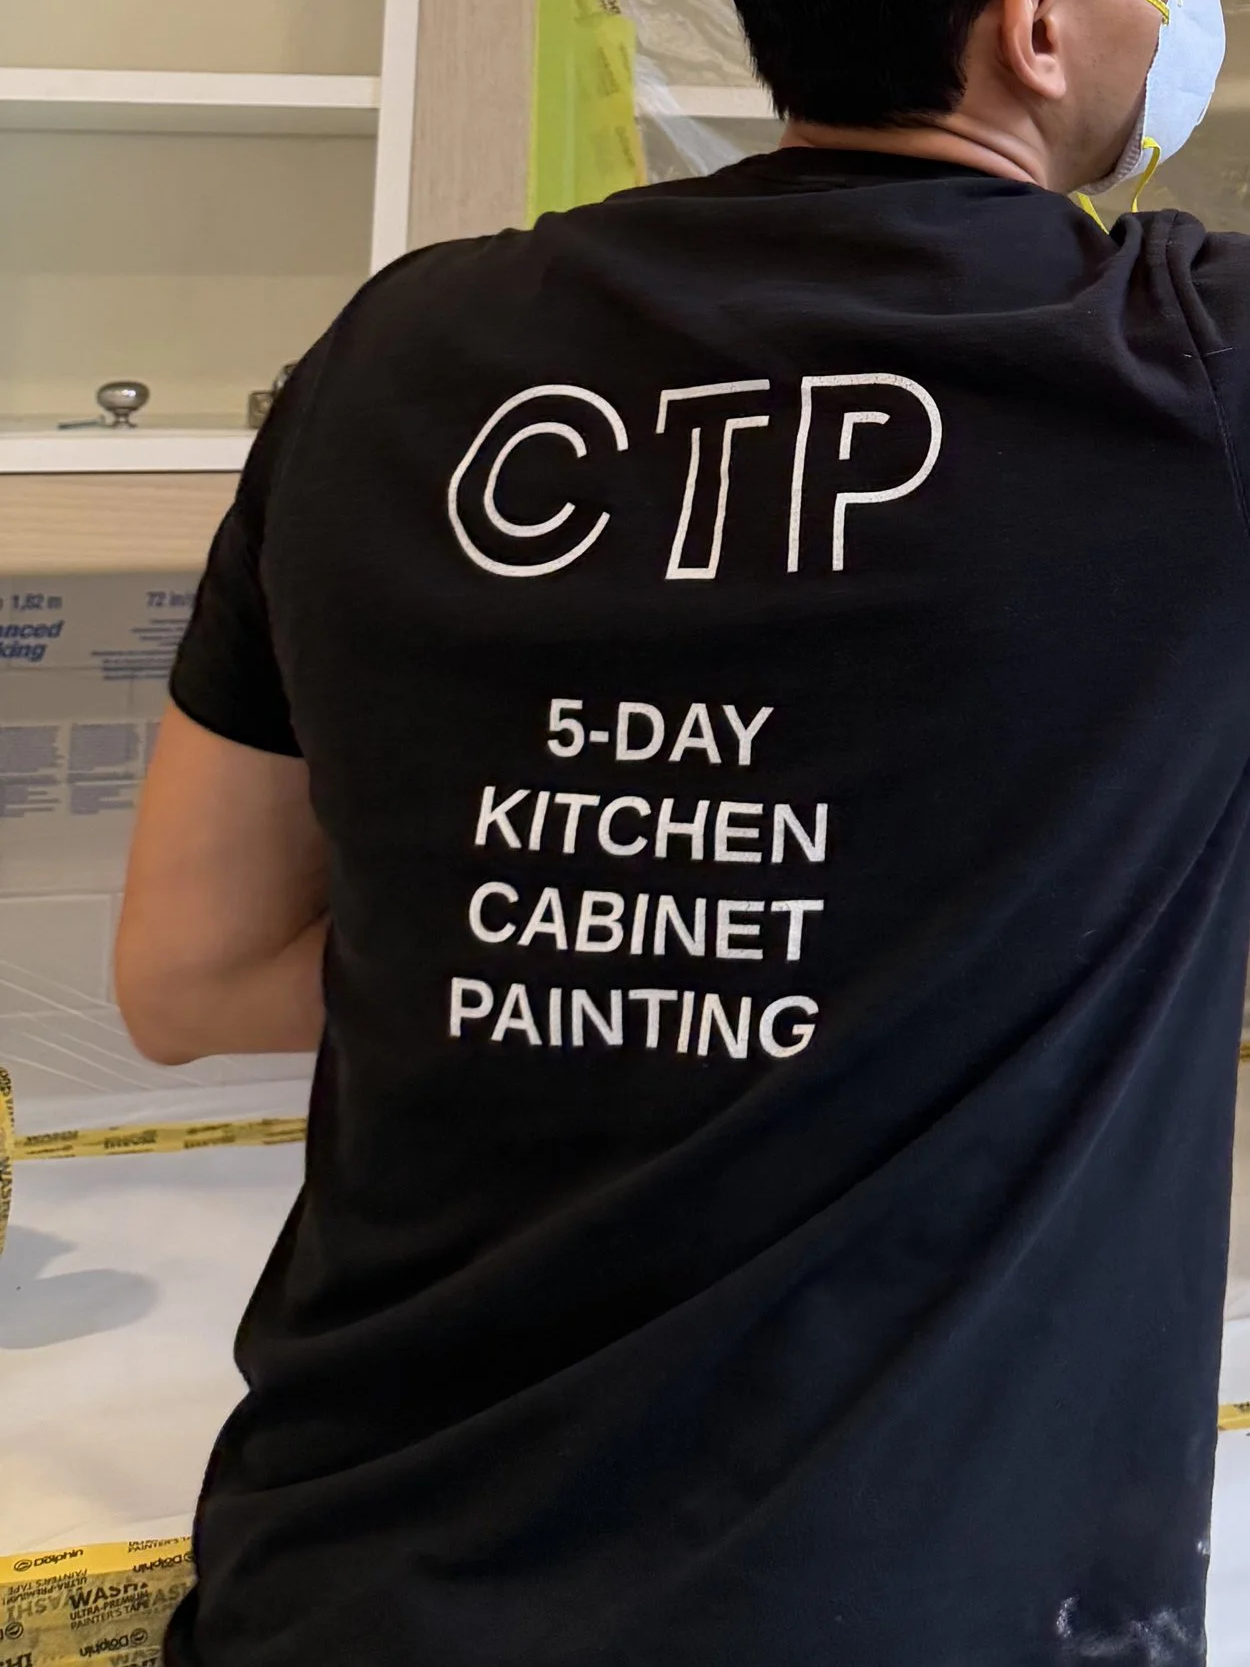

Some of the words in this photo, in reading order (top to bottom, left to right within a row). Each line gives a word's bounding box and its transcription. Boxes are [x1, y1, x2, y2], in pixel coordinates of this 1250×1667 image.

[448, 372, 943, 580] CTP
[147, 592, 166, 607] 72
[546, 698, 775, 766] 5-DAY
[473, 784, 829, 864] KITCHEN
[468, 880, 825, 962] CABINET
[448, 976, 821, 1060] PAINTING
[33, 1549, 84, 1567] Dolphin
[132, 1553, 182, 1574] Dolphin
[69, 1591, 148, 1621] ULTRA-PREMIUM
[70, 1607, 122, 1630] PAINTER'S
[124, 1600, 148, 1614] TAPE
[79, 1634, 130, 1657] Dolphin
